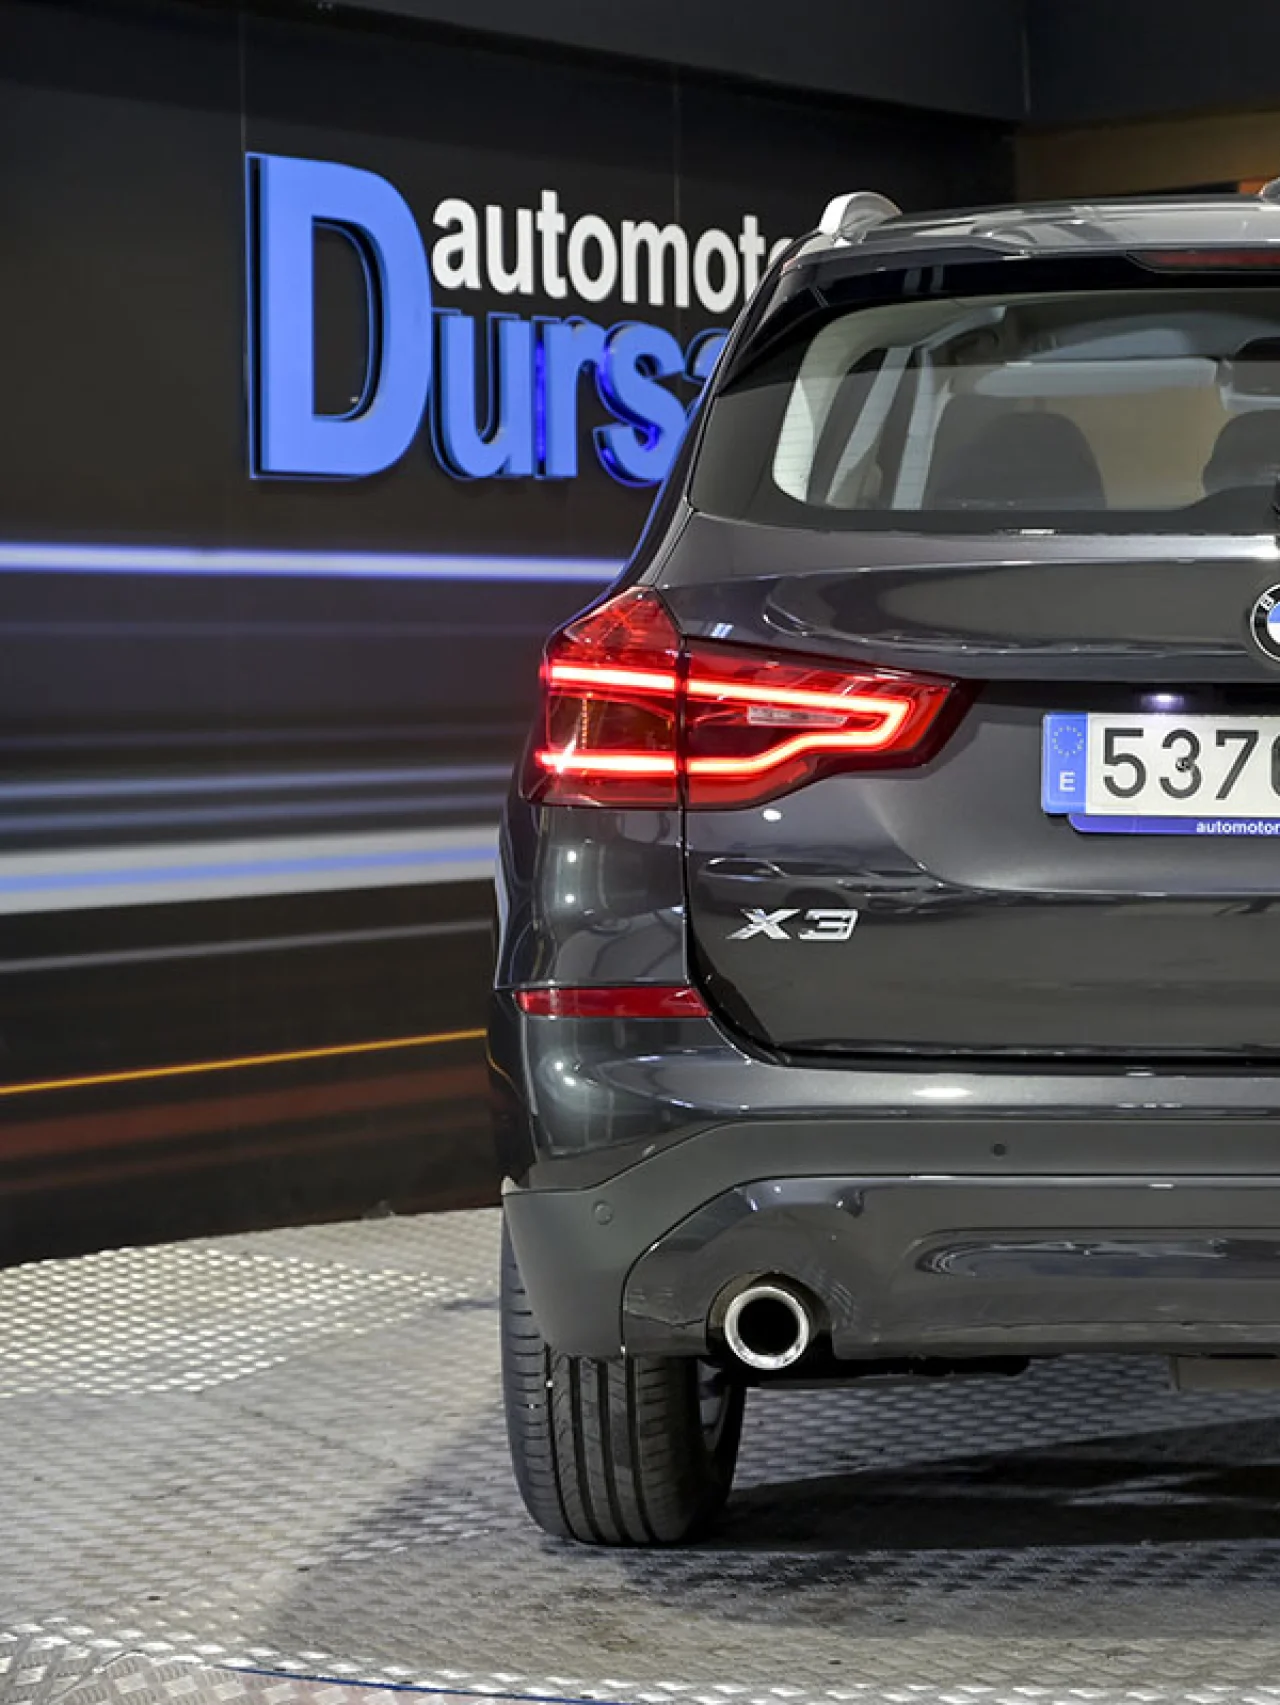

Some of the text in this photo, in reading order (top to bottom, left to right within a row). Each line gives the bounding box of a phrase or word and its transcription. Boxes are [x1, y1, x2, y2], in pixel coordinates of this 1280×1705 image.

[431, 190, 794, 313] automot
[245, 152, 730, 488] Durs
[1058, 771, 1076, 792] E
[725, 908, 859, 941] X3
